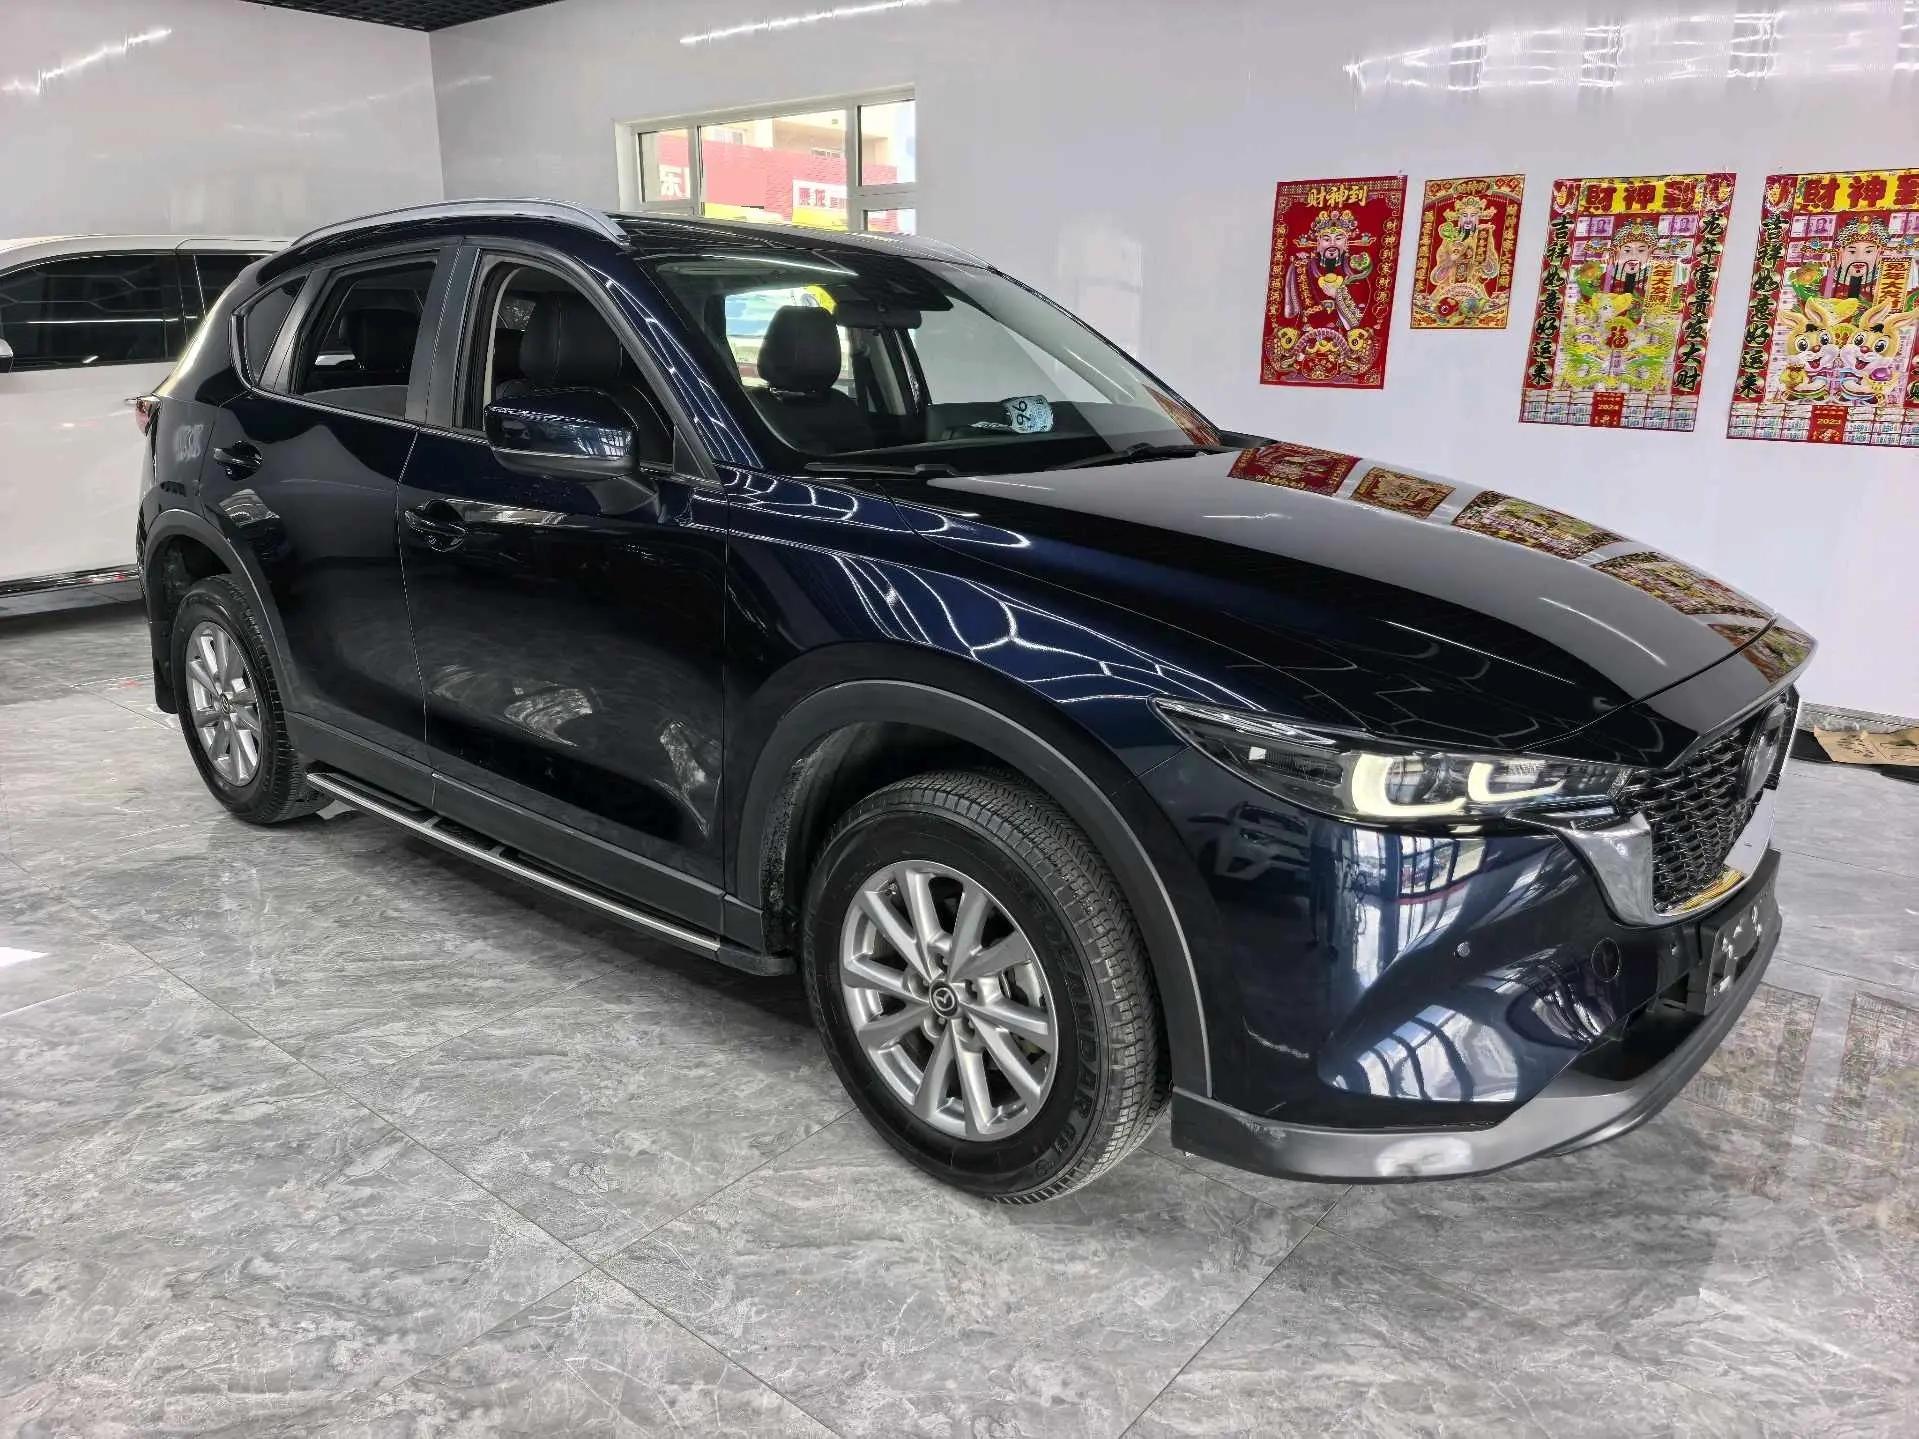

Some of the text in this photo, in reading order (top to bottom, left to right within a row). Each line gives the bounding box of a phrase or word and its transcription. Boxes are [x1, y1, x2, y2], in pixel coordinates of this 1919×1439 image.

[1305, 184, 1368, 208] 财神到
[1530, 214, 1574, 386] 吉祥如意好运来
[1673, 211, 1725, 391] 龙年富贵发大财
[1737, 214, 1790, 398] 吉祥如意好运来
